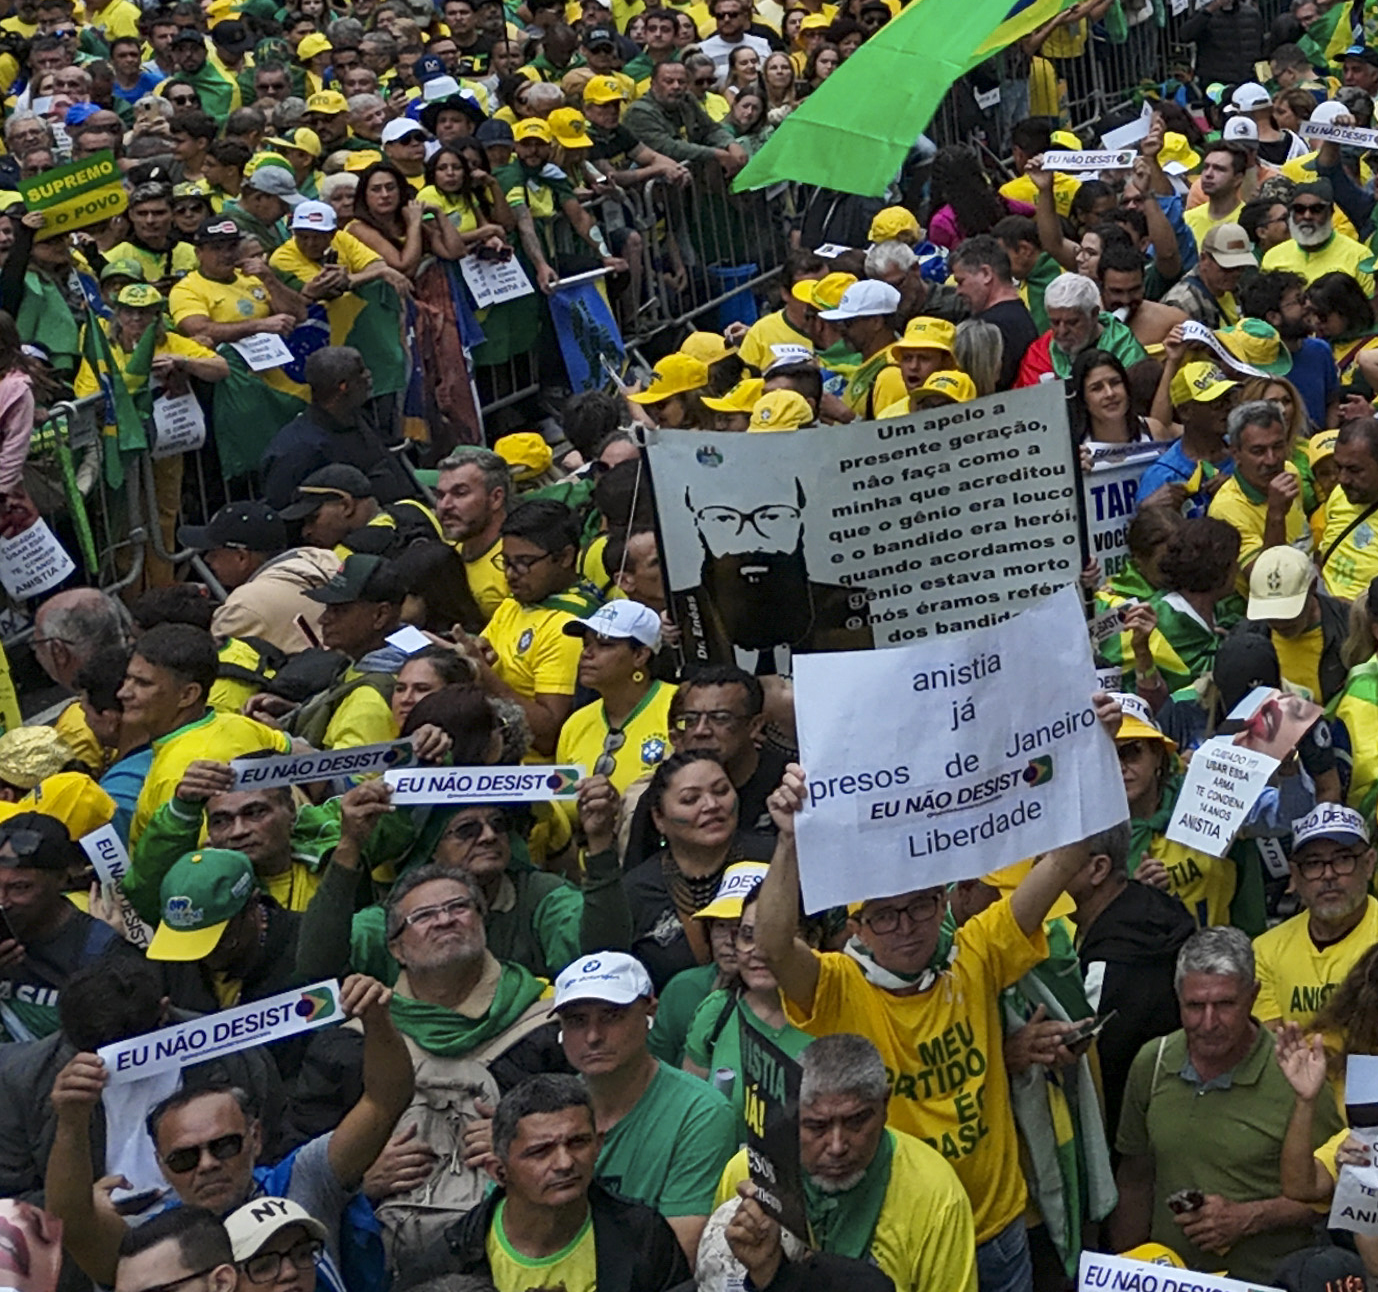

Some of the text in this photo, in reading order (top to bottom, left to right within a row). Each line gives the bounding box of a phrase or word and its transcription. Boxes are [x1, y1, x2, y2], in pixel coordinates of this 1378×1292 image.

[27, 161, 114, 203] SUPREMO
[74, 192, 121, 220] POVO
[877, 404, 1005, 440] Um apelo a
[840, 420, 1048, 472] presente geração,
[901, 462, 951, 479] faça
[958, 448, 1020, 468] como
[1027, 444, 1040, 455] a
[832, 464, 1066, 517] minha que acreditou
[829, 487, 1074, 543] que o gênio era louco
[830, 510, 1077, 563] e o bandido era herói,
[839, 534, 1075, 586] quando acordamos o
[849, 559, 1069, 607] gênio estava morto
[686, 595, 708, 660] Dr. Enéas
[847, 617, 863, 629] e
[868, 608, 908, 625] nós
[916, 590, 1000, 614] éramos
[888, 626, 928, 643] dos
[913, 651, 1002, 692] anistia
[951, 697, 976, 731] já
[240, 767, 268, 784] EU
[271, 758, 313, 780] NÃO
[809, 766, 910, 807] presos
[945, 753, 980, 779] de
[1006, 708, 1096, 759] Janeiro
[1228, 768, 1250, 781] ESSA
[396, 777, 425, 793] EU
[428, 772, 472, 792] NÃO
[1196, 785, 1206, 797] TE
[1213, 778, 1235, 792] ARMA
[870, 801, 900, 820] EU
[905, 792, 952, 814] NÃO
[908, 800, 1042, 858] Liberdade
[1178, 812, 1220, 840] ANISTIA
[96, 837, 119, 859] EU
[116, 1046, 148, 1072] EU
[155, 1029, 207, 1060] NÃO
[917, 1016, 975, 1067] MEU
[1360, 1184, 1375, 1197] TE
[250, 1199, 288, 1223] NY
